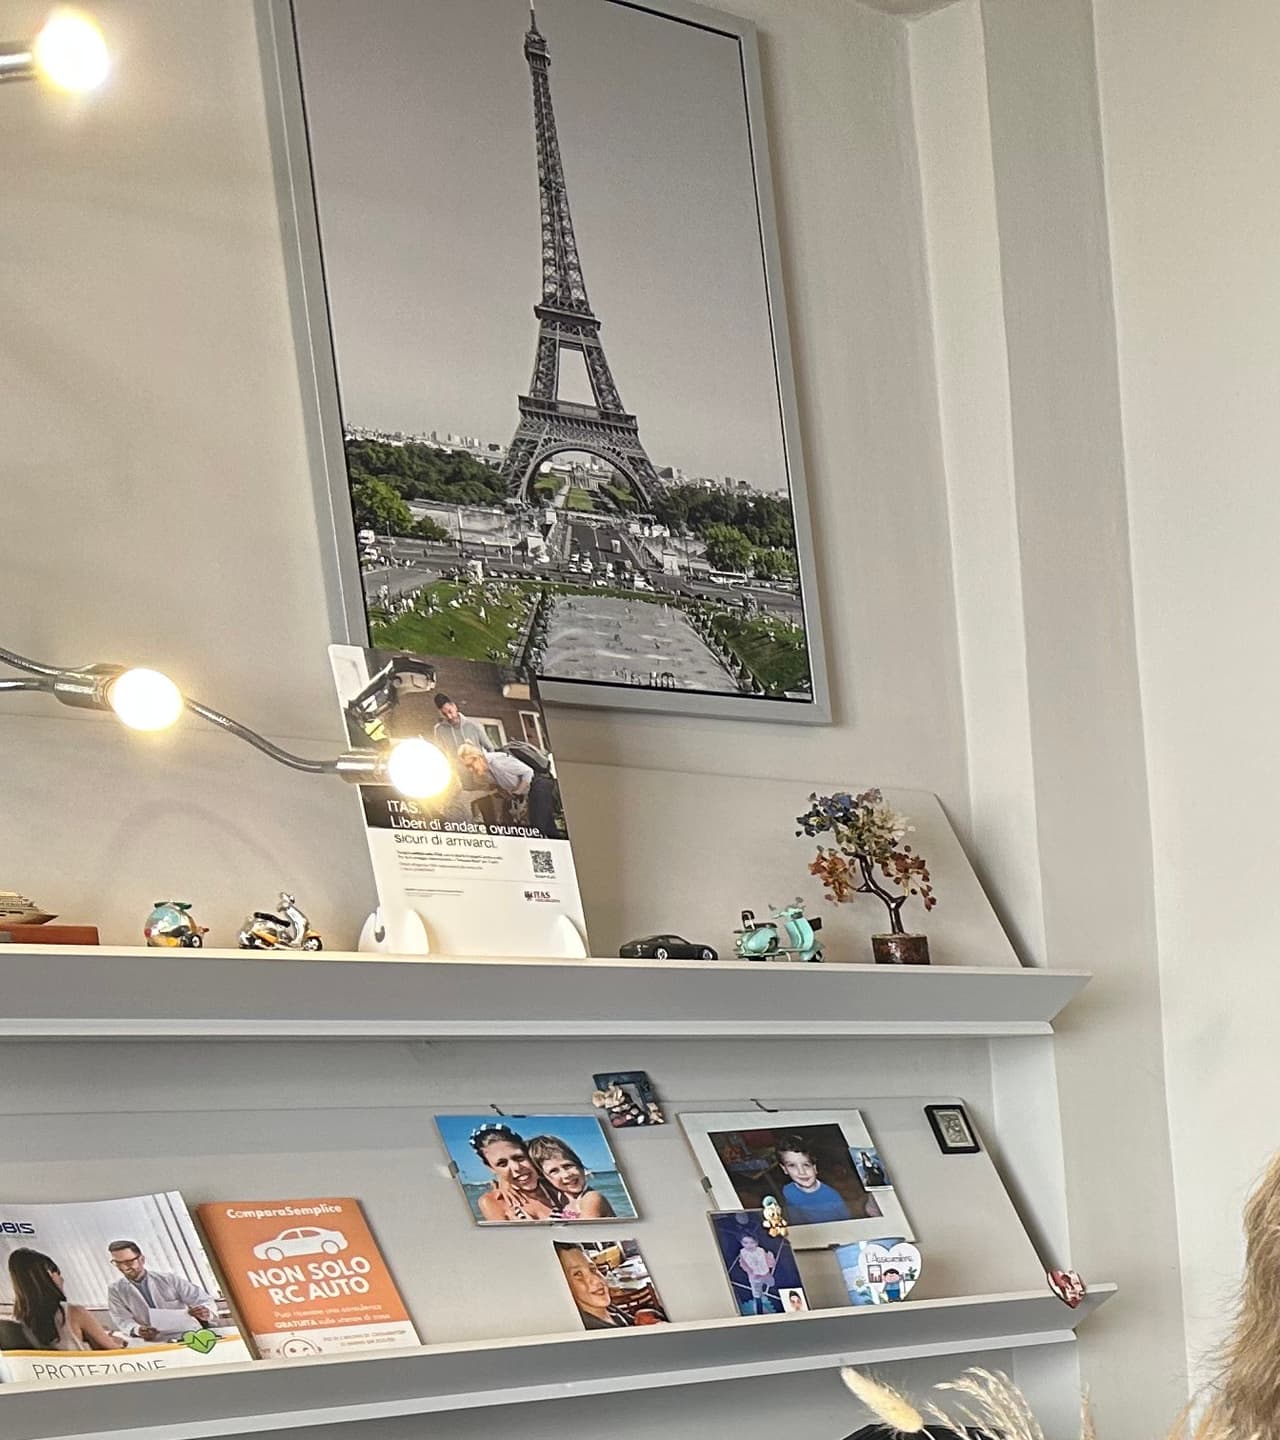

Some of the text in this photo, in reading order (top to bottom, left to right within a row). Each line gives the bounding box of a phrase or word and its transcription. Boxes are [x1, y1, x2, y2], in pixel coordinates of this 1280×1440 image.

[390, 815, 544, 838] Liberi di andare ovunque,
[394, 833, 498, 849] sicuri di arrivarci.
[226, 1203, 343, 1219] ComparaSemplice
[247, 1256, 371, 1288] NON SOLO
[269, 1276, 370, 1306] RC AUTO
[274, 1319, 318, 1329] GRATUITA
